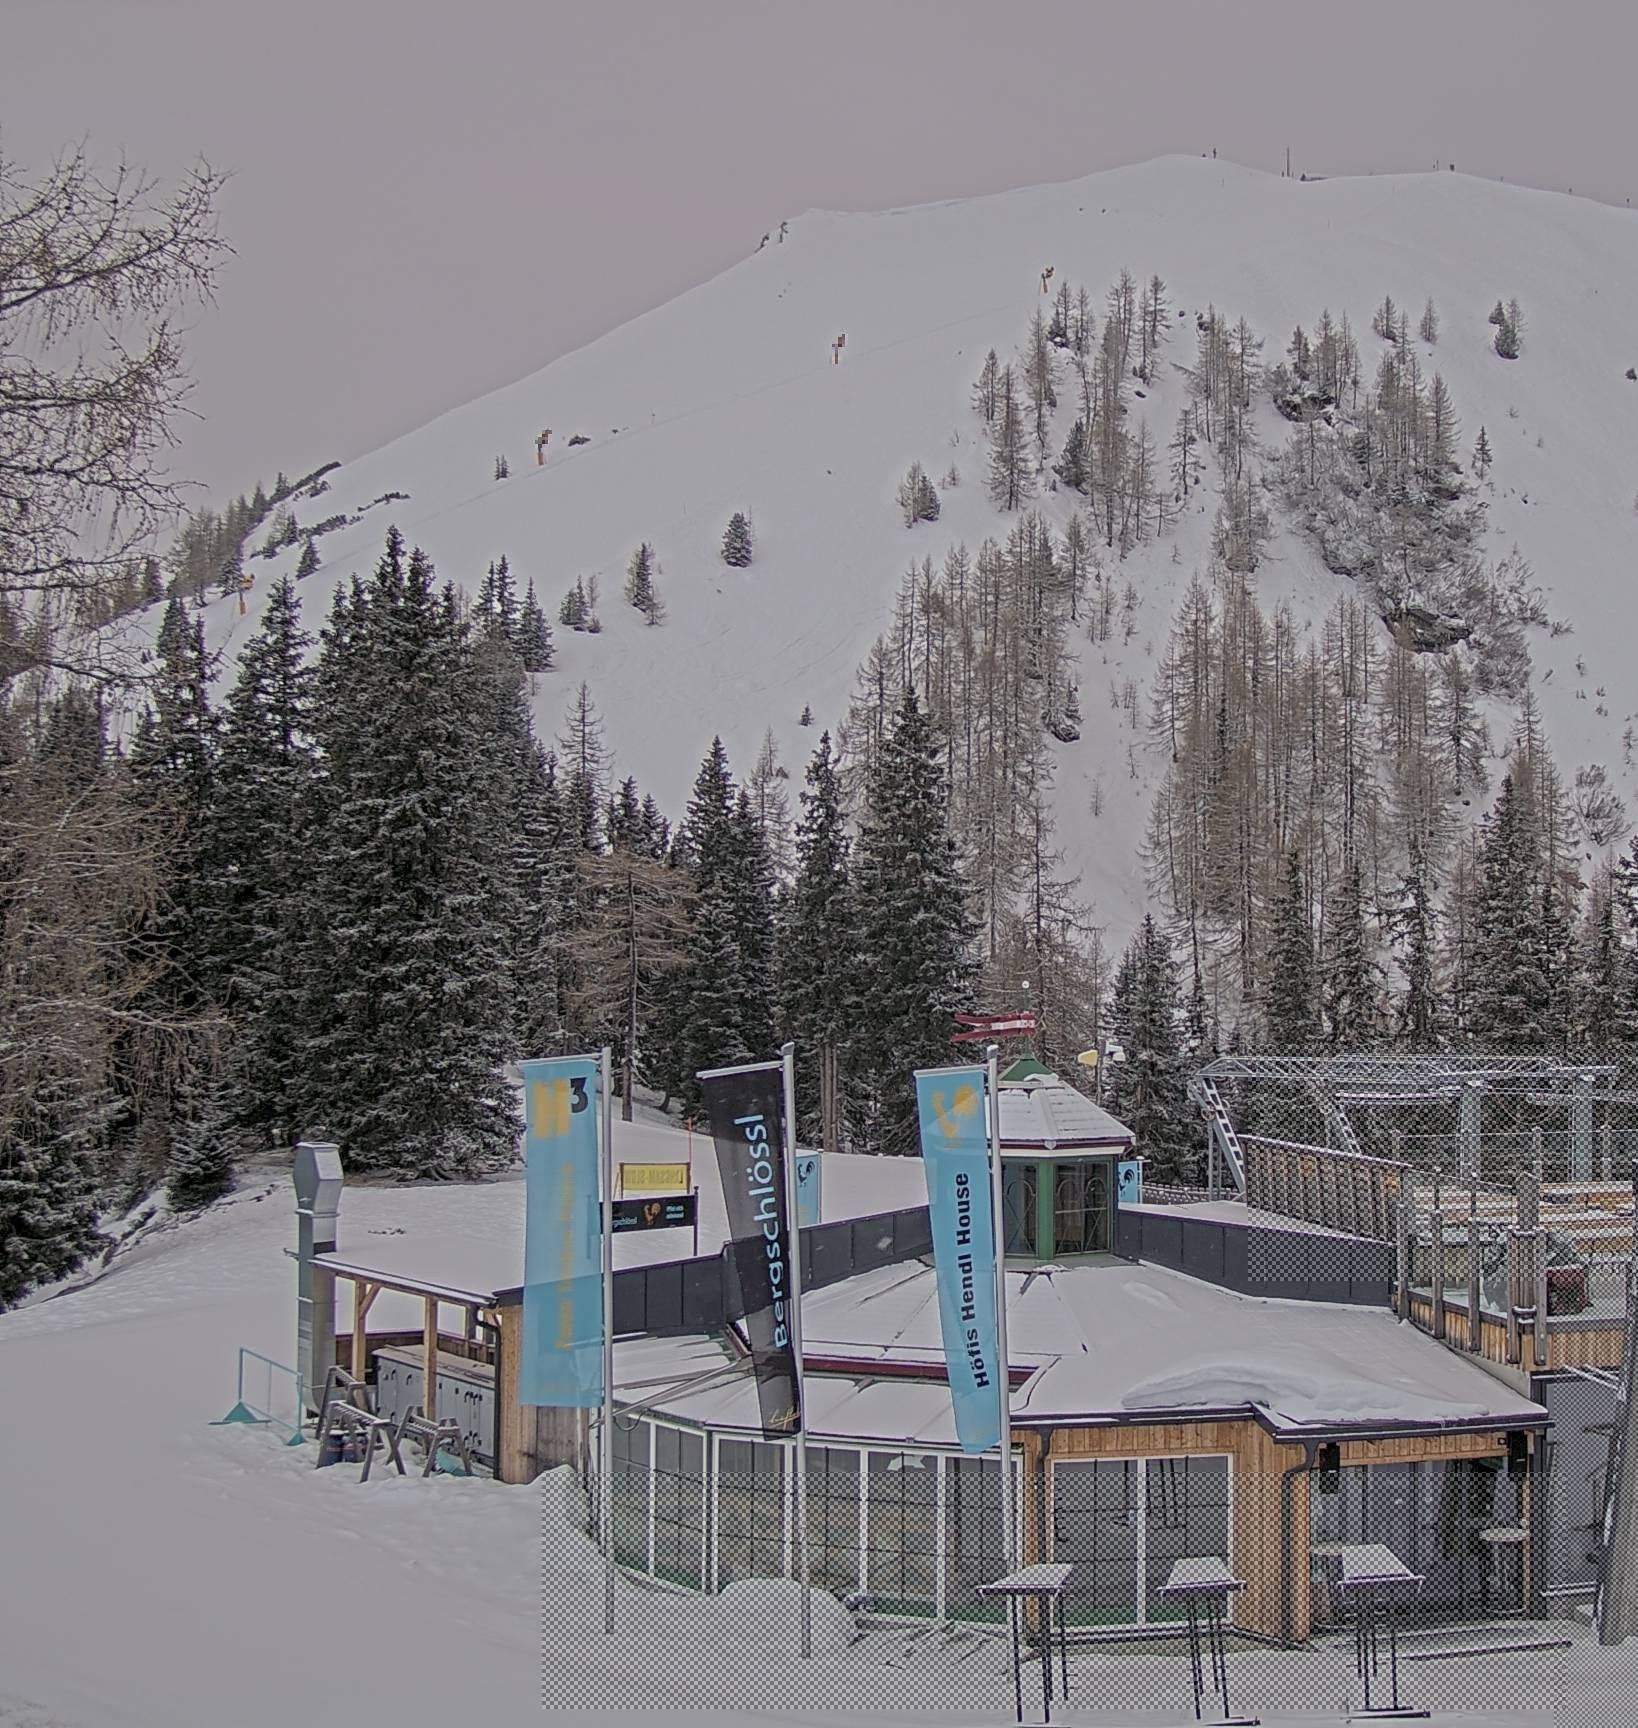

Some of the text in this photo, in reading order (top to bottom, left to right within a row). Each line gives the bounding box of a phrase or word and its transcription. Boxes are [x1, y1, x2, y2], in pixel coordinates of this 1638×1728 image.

[734, 1113, 788, 1348] Bergschlössl
[955, 1172, 972, 1246] House
[958, 1253, 976, 1322] Hendl
